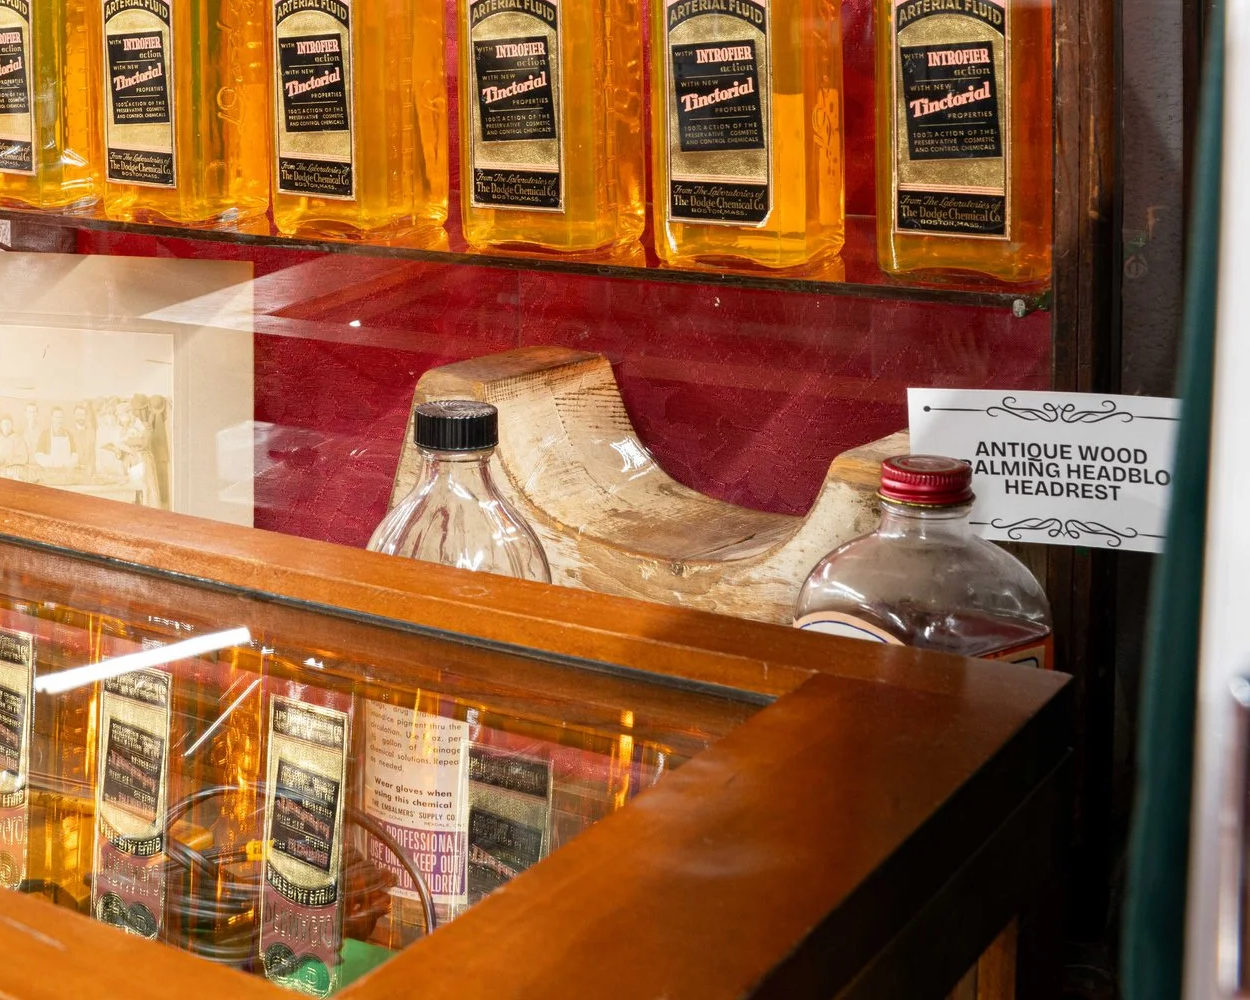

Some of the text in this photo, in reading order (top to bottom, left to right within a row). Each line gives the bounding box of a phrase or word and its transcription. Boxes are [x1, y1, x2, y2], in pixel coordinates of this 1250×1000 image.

[729, 0, 763, 24] FLUID
[965, 0, 1002, 25] FLUID
[1, 44, 22, 52] action
[123, 37, 162, 51] INTROFIER
[296, 39, 339, 55] INTROFIER
[495, 42, 545, 58] INTROFIER
[139, 50, 162, 58] action
[314, 54, 340, 63] action
[696, 46, 753, 63] INTROFIER
[903, 48, 990, 67] WITH INTROFIER
[516, 58, 546, 67] action
[720, 62, 753, 72] action
[953, 65, 990, 76] action
[113, 63, 163, 91] Tinctorial
[285, 67, 340, 98] Tinctorial
[482, 72, 547, 104] Tinctorial
[681, 77, 754, 112] Tinctorial
[910, 81, 991, 118] Tinctorial
[948, 111, 993, 119] PROPERTIES
[901, 205, 917, 217] The
[920, 208, 947, 220] Dodge
[949, 208, 988, 221] Chemical
[976, 441, 1148, 464] ANTIQUE WOOD
[1005, 480, 1122, 501] HEADREST
[393, 706, 408, 716] drug
[449, 722, 461, 730] the
[382, 738, 402, 748] gallon
[398, 754, 431, 765] solutions.
[375, 776, 393, 789] Wear
[396, 785, 423, 796] gloves
[374, 789, 452, 809] using this chemical
[382, 803, 415, 817] EMBALMERS'
[419, 812, 442, 820] SUPPLY
[371, 838, 384, 861] USE
[413, 853, 436, 873] KEEP
